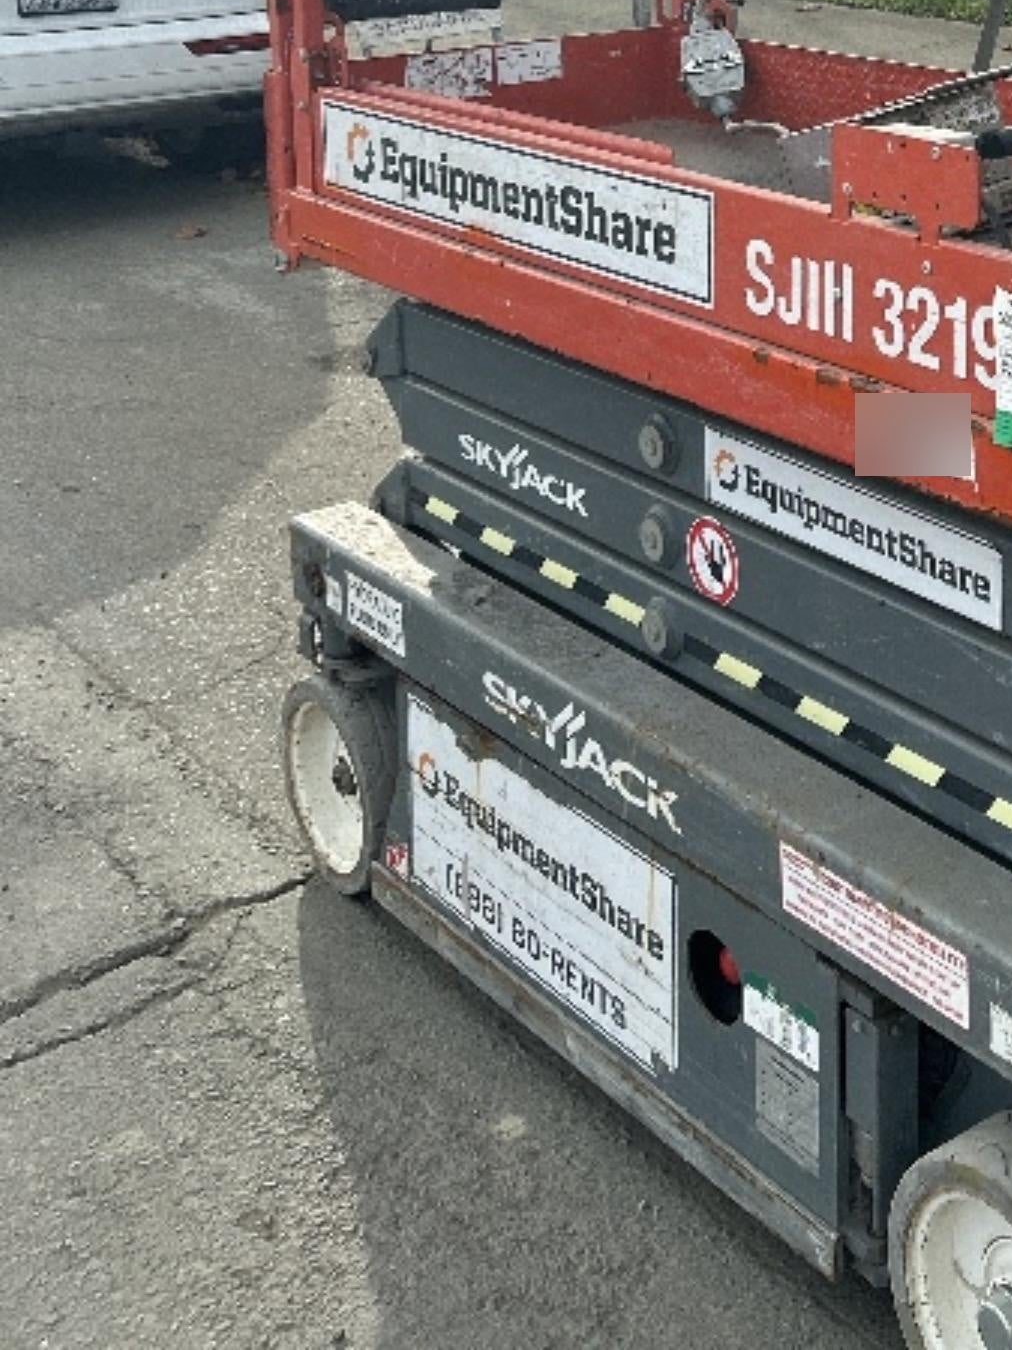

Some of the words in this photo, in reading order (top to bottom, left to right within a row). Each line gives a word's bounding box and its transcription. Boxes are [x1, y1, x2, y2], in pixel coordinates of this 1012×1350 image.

[380, 137, 676, 264] EquipmentShare
[872, 277, 999, 392] 3219
[458, 433, 589, 517] SKYJACK
[743, 462, 991, 603] EquipmentShare
[481, 670, 684, 837] SKYJACK
[442, 769, 665, 961] EquipmentShare
